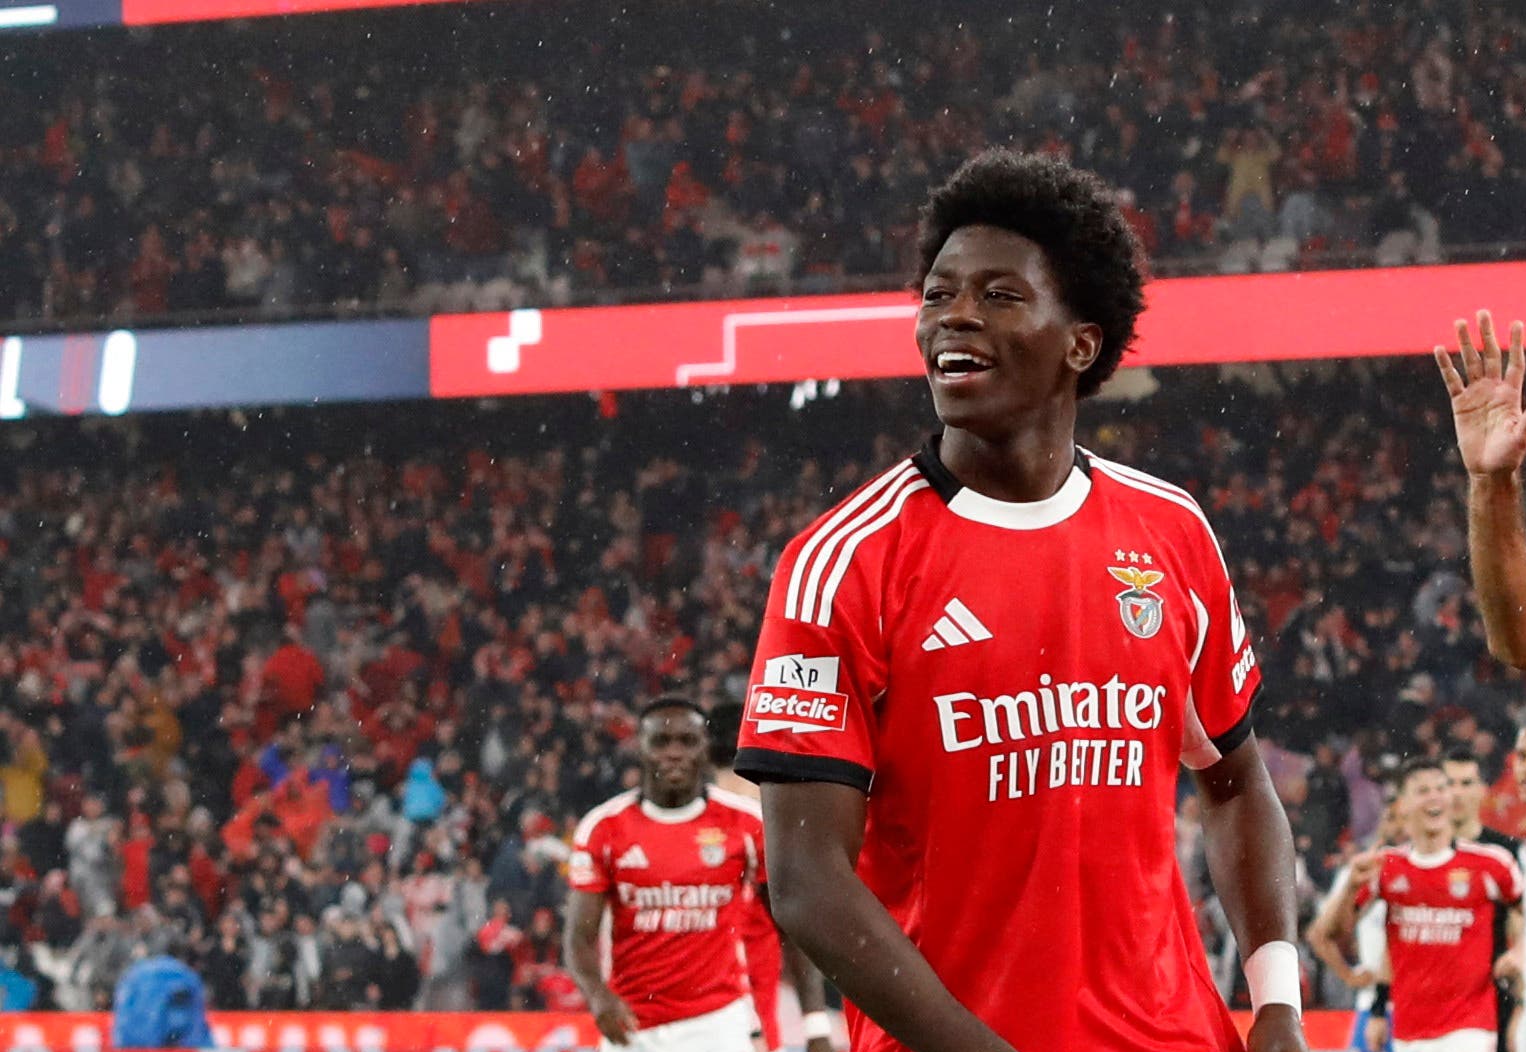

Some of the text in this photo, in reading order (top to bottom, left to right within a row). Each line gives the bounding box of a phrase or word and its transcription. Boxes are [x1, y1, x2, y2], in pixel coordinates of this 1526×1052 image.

[755, 692, 839, 721] Betclic
[934, 673, 1166, 752] Emirates
[989, 739, 1143, 802] FLY BETTER
